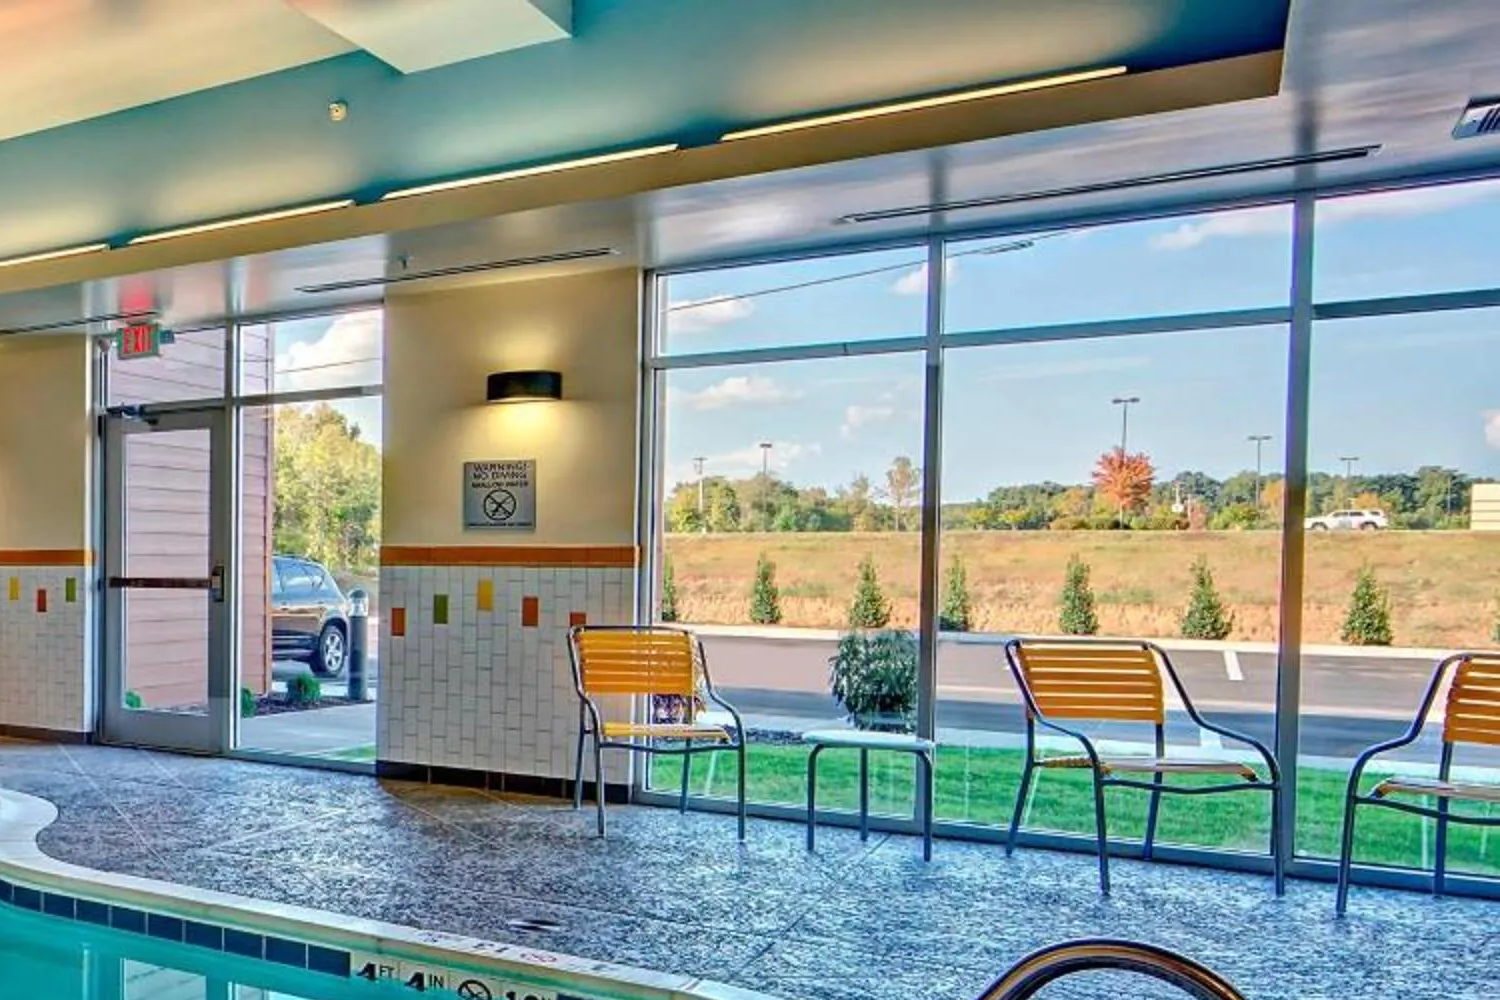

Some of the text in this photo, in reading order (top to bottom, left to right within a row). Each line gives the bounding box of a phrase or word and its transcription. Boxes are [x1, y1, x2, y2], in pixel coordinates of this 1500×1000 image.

[123, 325, 152, 353] EXIT
[356, 963, 444, 992] 4 FT 4 IN
